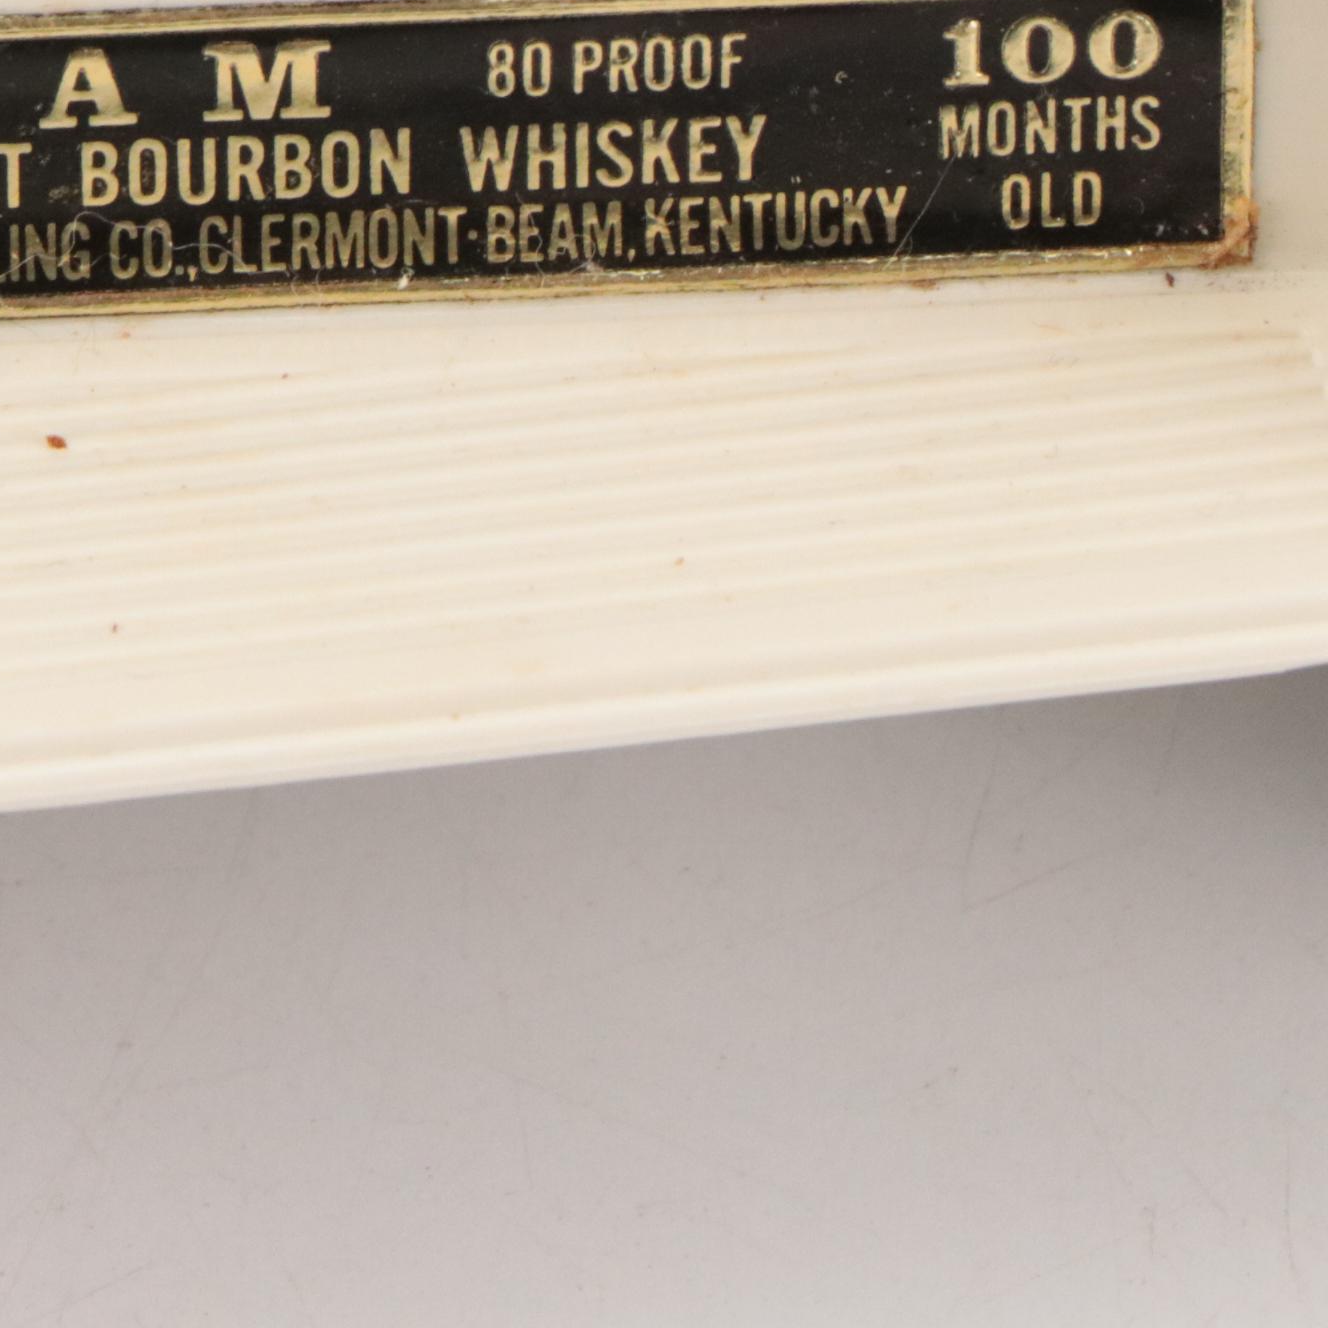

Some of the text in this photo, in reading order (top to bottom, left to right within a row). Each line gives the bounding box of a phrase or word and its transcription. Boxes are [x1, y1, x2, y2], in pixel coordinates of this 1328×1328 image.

[486, 31, 747, 99] 80 PROOF
[940, 9, 1164, 88] 100
[80, 127, 413, 207] BOURBON
[459, 114, 768, 193] WHISKEY
[937, 95, 1162, 162] MONTHS
[643, 185, 909, 257] KENTUCKY
[1001, 170, 1104, 231] OLD
